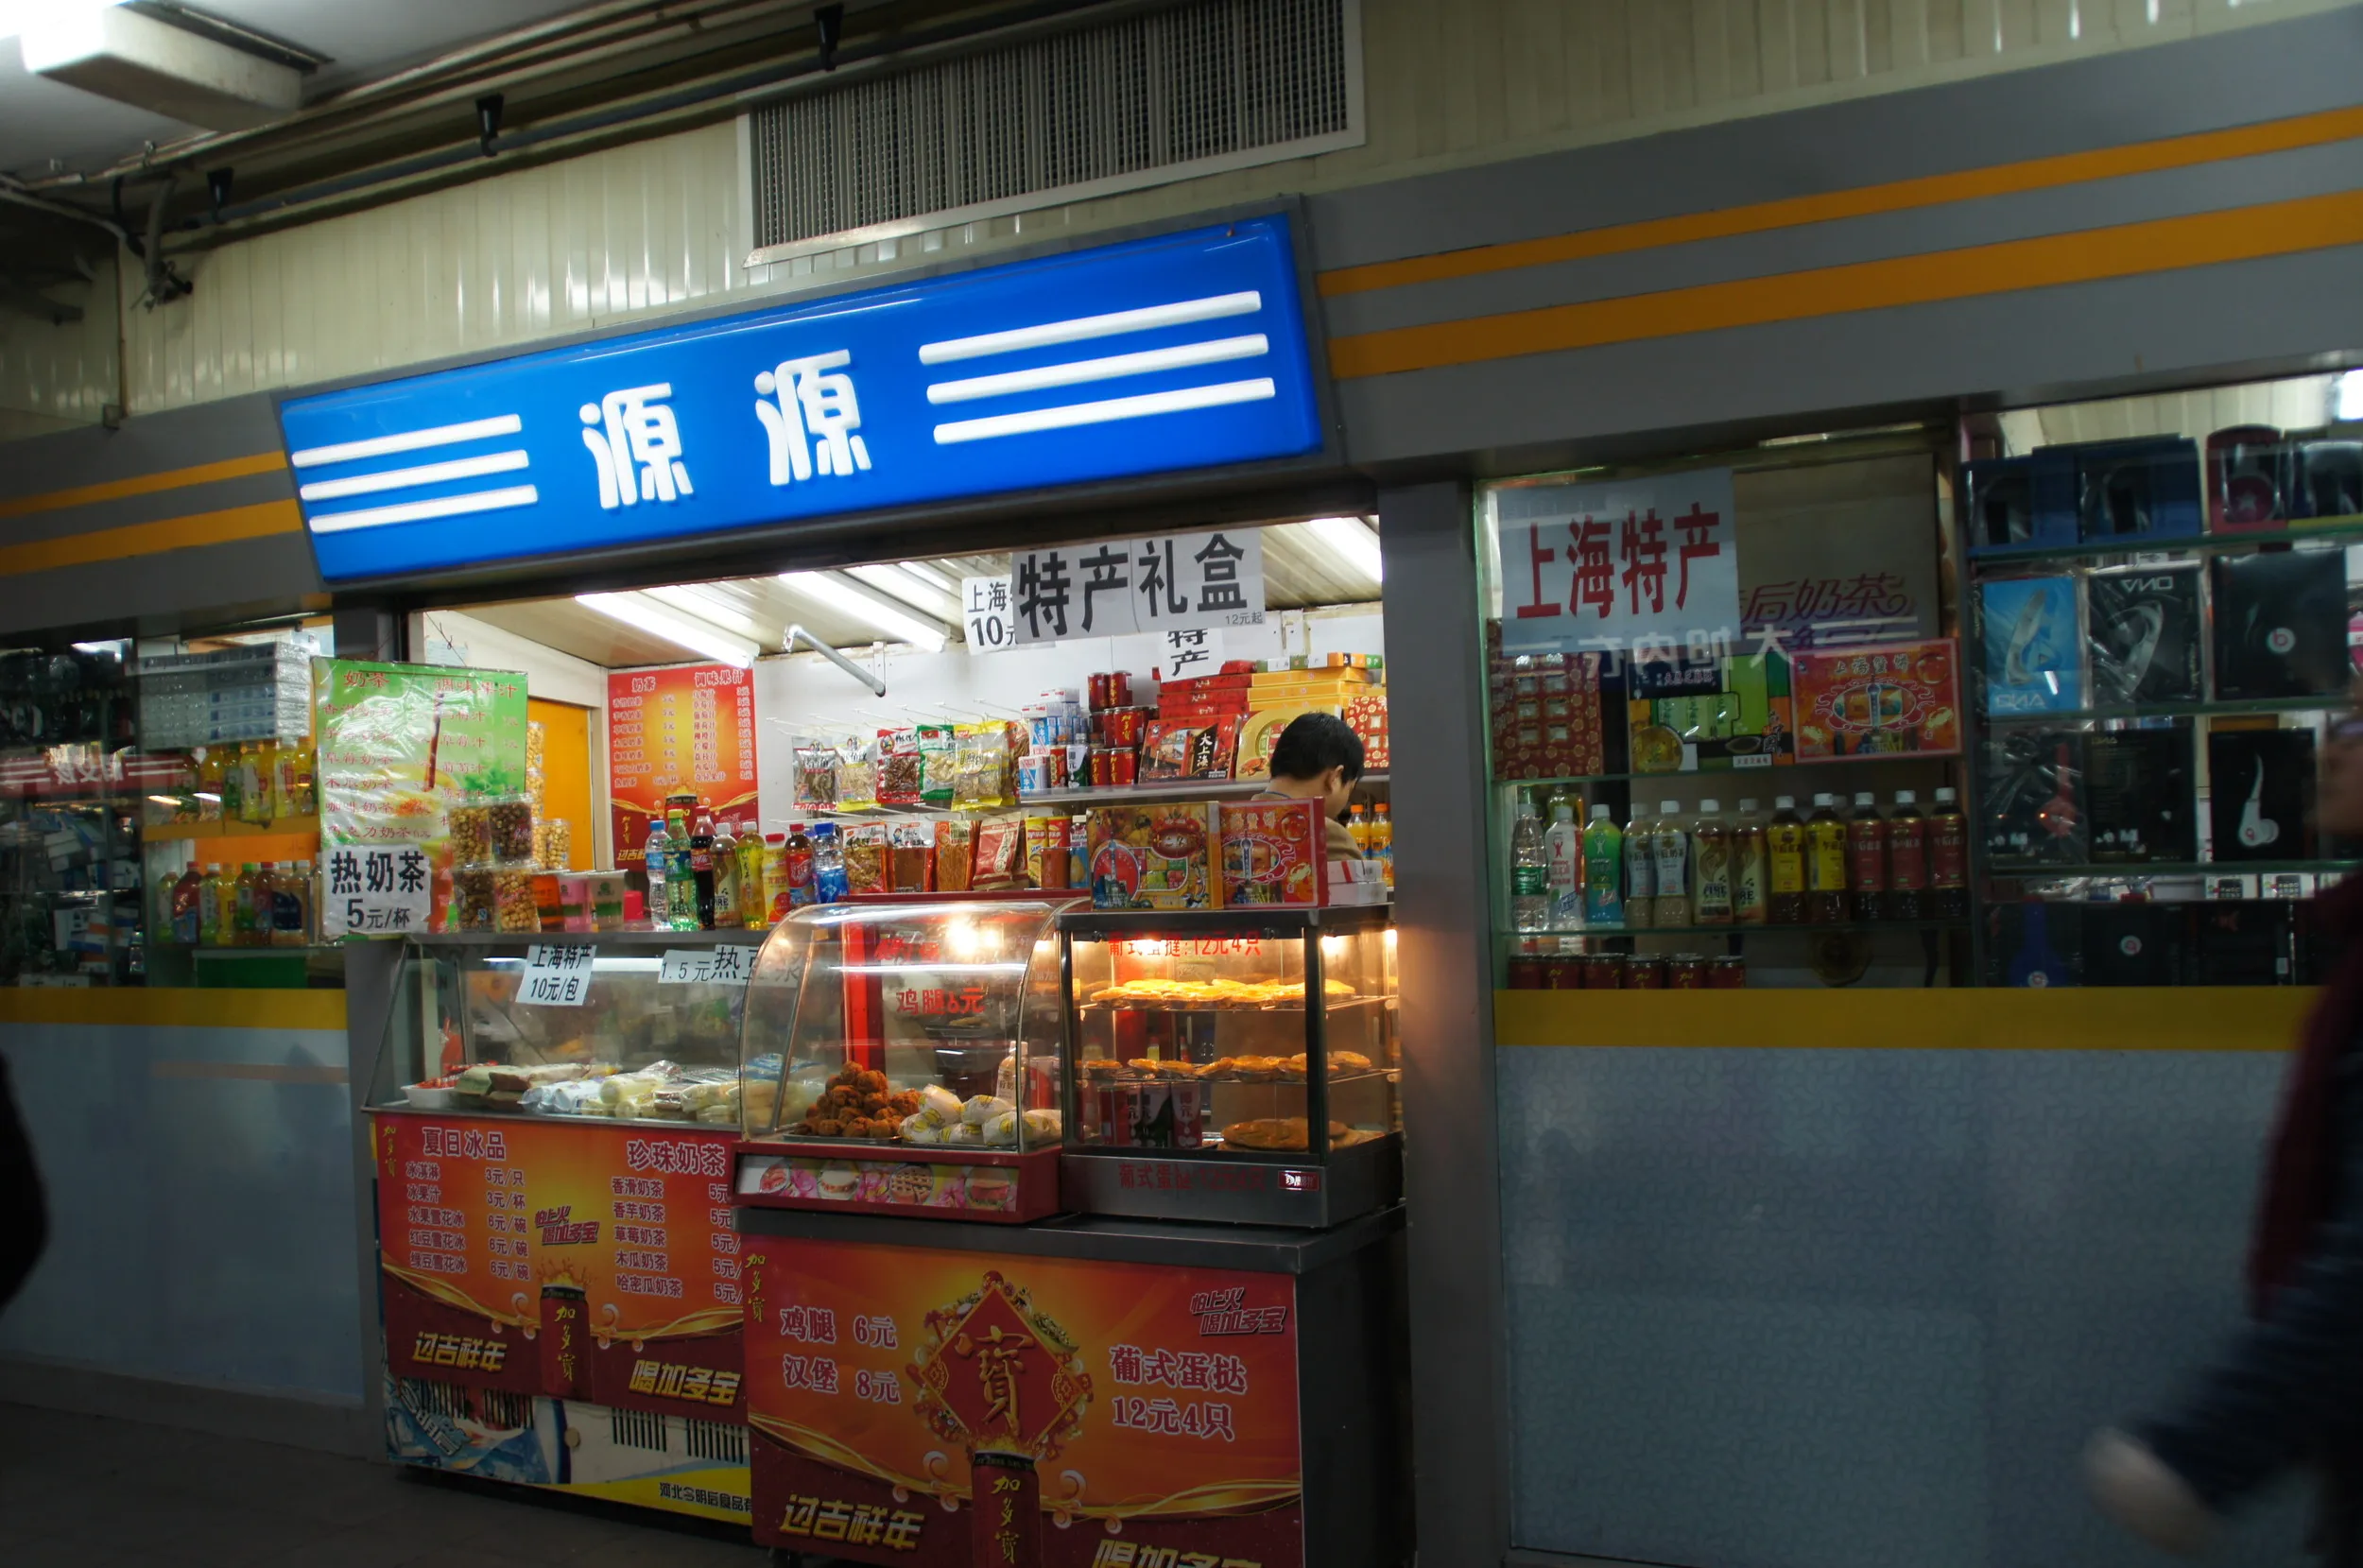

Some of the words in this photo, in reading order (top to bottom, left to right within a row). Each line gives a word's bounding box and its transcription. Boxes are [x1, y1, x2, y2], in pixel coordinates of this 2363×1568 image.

[1516, 502, 1721, 620] 上海特产
[968, 581, 1012, 612] 上海
[1018, 533, 1248, 638] 特产礼盒
[1225, 612, 1263, 625] 12元起
[1739, 572, 1908, 623] 后奶茶
[344, 671, 389, 688] 奶茶
[632, 677, 656, 692] 奶茶
[695, 669, 744, 687] 调味果汁
[1195, 732, 1215, 767] 大上海
[332, 851, 425, 894] 热奶茶
[347, 899, 410, 928] 5元/杯
[532, 943, 592, 970] 上海特产
[530, 975, 579, 1002] 10元/包
[896, 988, 987, 1015] 鸡腿6元
[422, 1127, 507, 1162] 夏日冰品
[627, 1139, 726, 1176] 珍珠奶茶
[406, 1162, 440, 1181] 冰淇淋
[485, 1167, 525, 1188] 3元/只
[612, 1177, 664, 1198] 香滑奶茶
[407, 1184, 441, 1203] 冰果汁
[486, 1191, 526, 1210] 3元/杯
[612, 1200, 665, 1223] 香芋奶茶
[408, 1207, 465, 1228] 水果雪花冰
[488, 1214, 527, 1234] 6元/碗
[409, 1231, 466, 1251] 红豆雪花冰
[489, 1237, 529, 1258] 6元/碗
[614, 1225, 666, 1247] 草莓奶茶
[410, 1251, 467, 1274] 绿豆雪花冰
[490, 1260, 530, 1282] 6元/碗
[615, 1250, 667, 1271] 木瓜奶茶
[616, 1274, 682, 1298] 哈密瓜奶茶
[1191, 1287, 1246, 1314] 怕上火
[780, 1306, 837, 1345] 鸡腿
[854, 1315, 898, 1351] 6元
[1200, 1305, 1287, 1336] 喝加多宝
[412, 1331, 508, 1373] 过吉祥年
[629, 1359, 741, 1405] 喝加多宝
[782, 1354, 838, 1395] 汉堡
[855, 1370, 902, 1405] 8元
[1110, 1344, 1248, 1395] 葡式蛋挞
[1112, 1395, 1235, 1441] 12元4只
[779, 1494, 927, 1551] 过吉祥年
